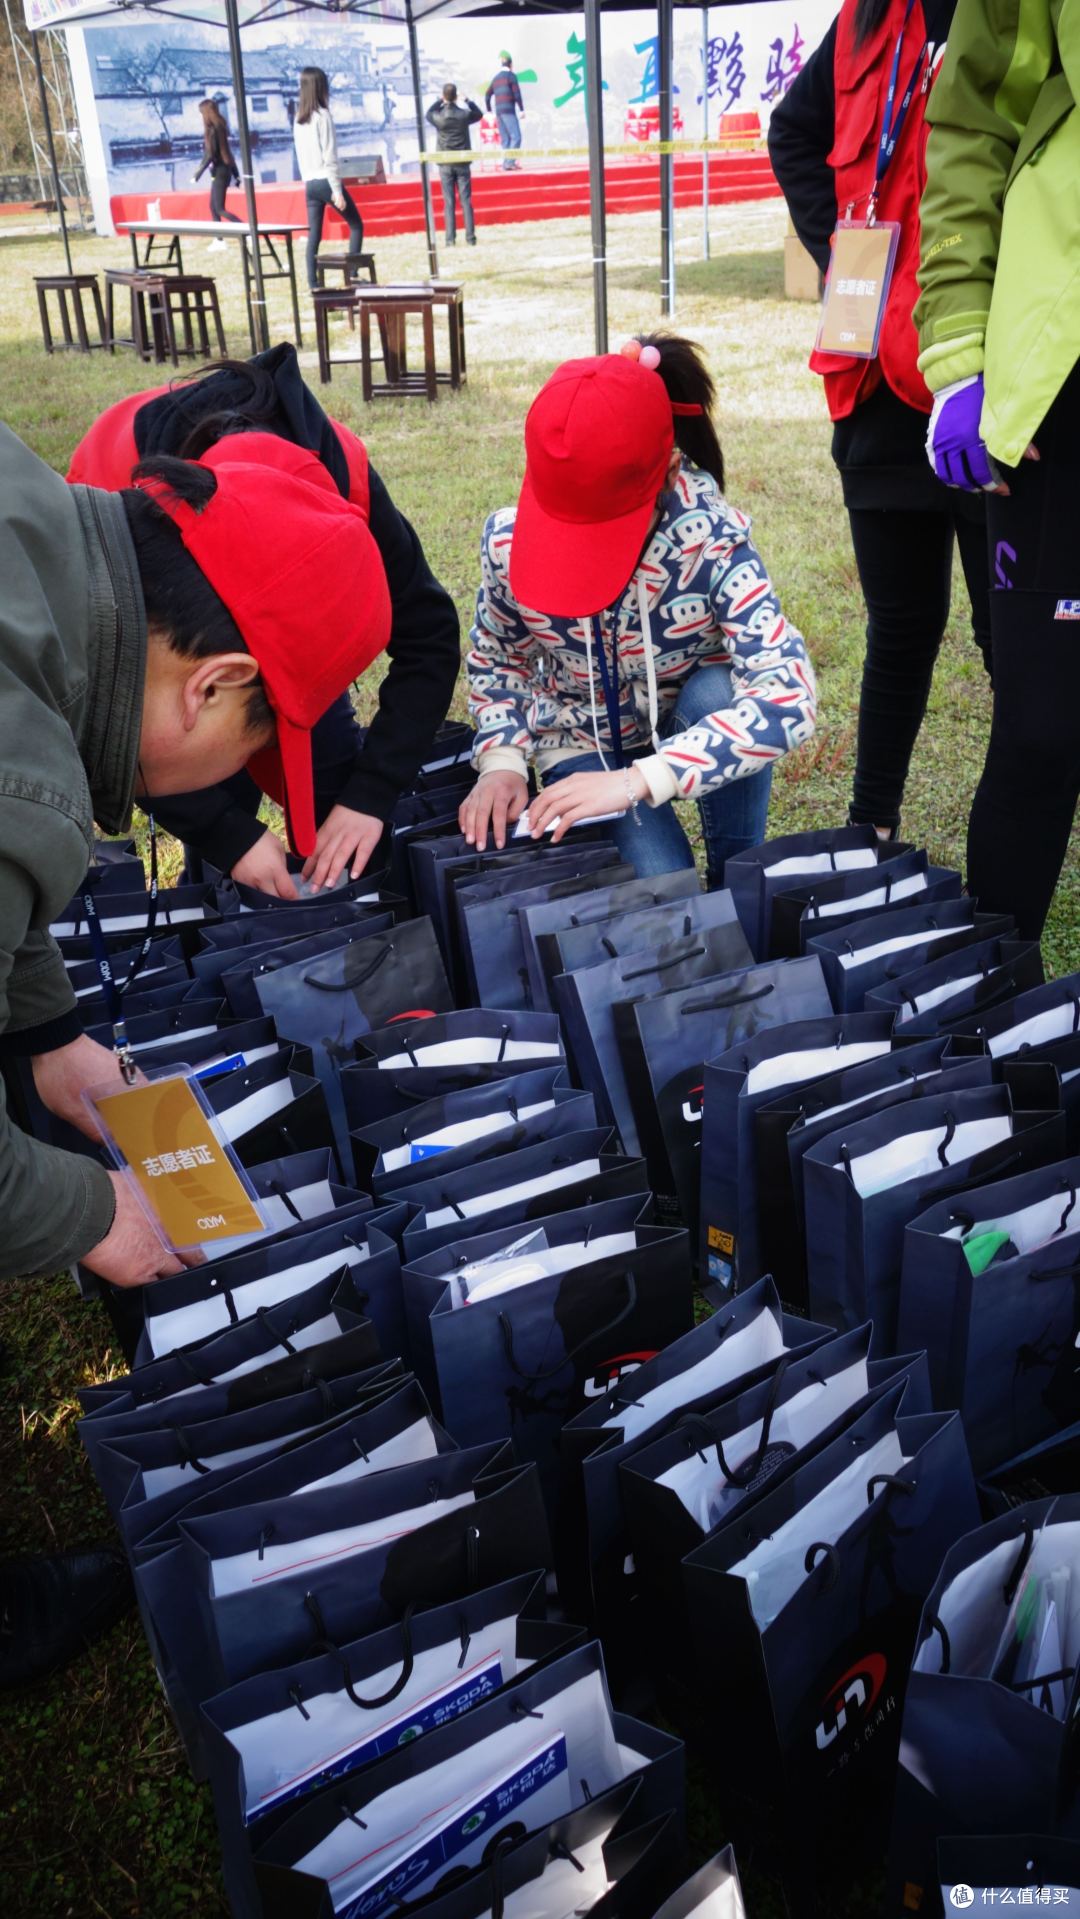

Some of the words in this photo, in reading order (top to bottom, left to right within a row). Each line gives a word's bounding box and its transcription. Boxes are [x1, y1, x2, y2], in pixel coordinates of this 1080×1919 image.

[836, 279, 877, 296] 志愿者证
[141, 1144, 216, 1177] 志愿者证
